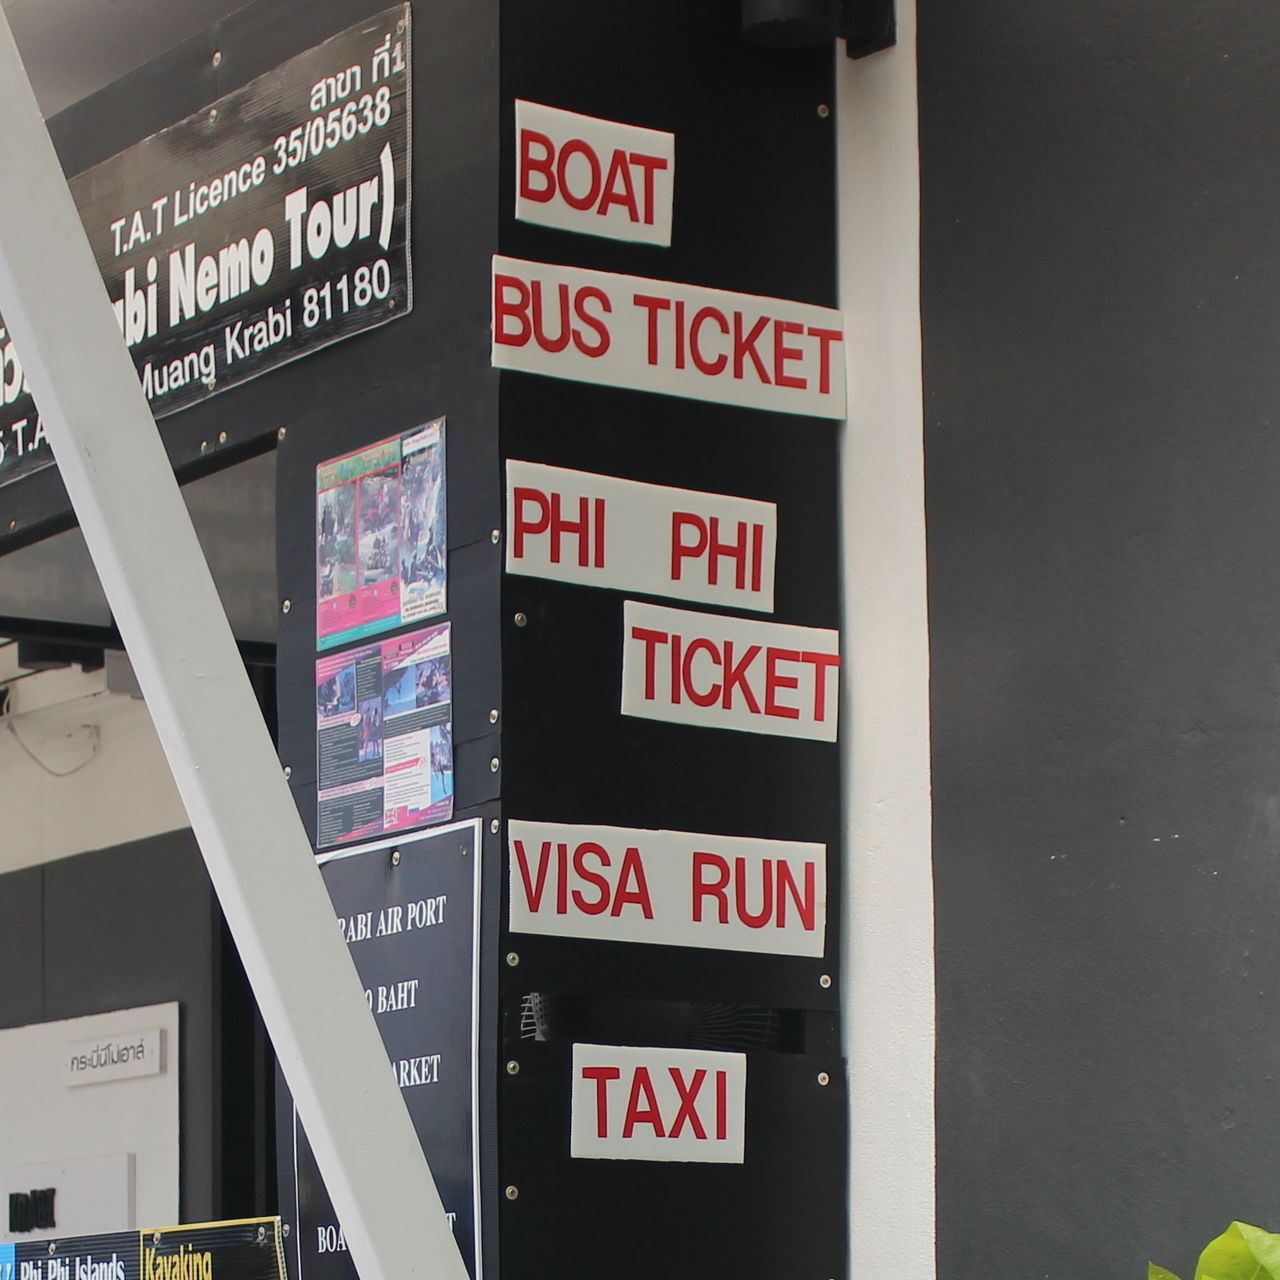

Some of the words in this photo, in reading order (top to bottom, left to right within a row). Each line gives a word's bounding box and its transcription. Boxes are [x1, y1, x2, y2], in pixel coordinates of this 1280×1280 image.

[309, 64, 362, 112] สาขา
[110, 196, 168, 257] T.A.T
[173, 155, 266, 227] Licence
[272, 85, 392, 175] 35/05638
[519, 127, 668, 225] BOAT
[168, 228, 275, 328] Nemo
[284, 141, 395, 271] Tour)
[224, 298, 293, 366] Krabi
[302, 257, 391, 329] 81180
[493, 273, 613, 358] BUS
[633, 293, 844, 395] TICKET
[512, 486, 606, 569] PHI
[670, 511, 764, 593] PHI
[631, 625, 842, 723] TICKET
[336, 910, 373, 944] RABI
[375, 905, 404, 938] AIR
[406, 895, 448, 931] PORT
[513, 839, 655, 920] VISA
[691, 850, 816, 932] RUN
[376, 979, 419, 1014] BAHT
[581, 1066, 727, 1140] TAXI
[316, 1224, 348, 1254] BOA
